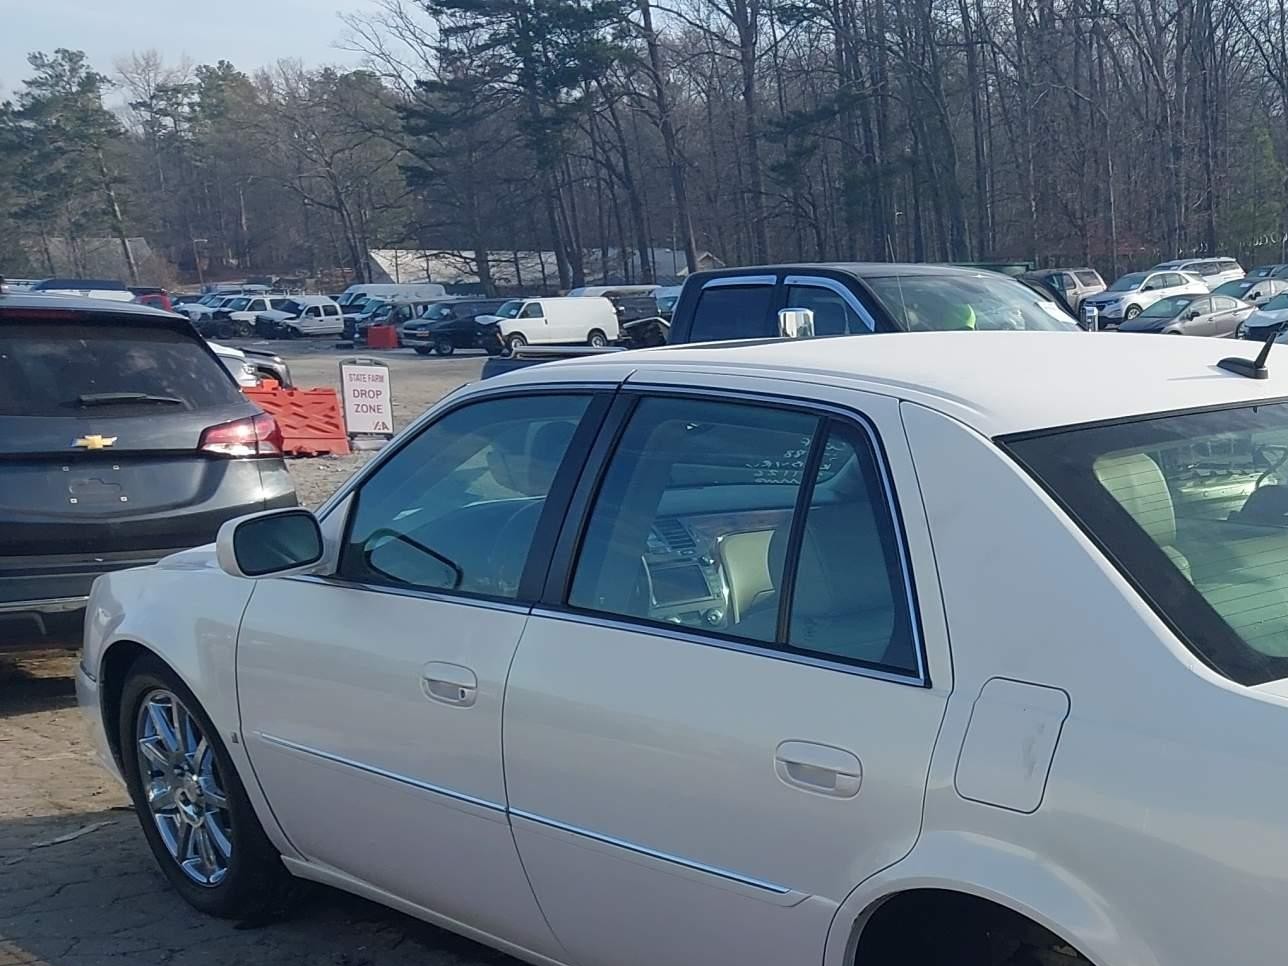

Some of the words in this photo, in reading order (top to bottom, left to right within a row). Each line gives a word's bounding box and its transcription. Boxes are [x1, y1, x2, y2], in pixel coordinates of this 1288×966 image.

[348, 373, 367, 383] STATE
[368, 374, 384, 383] FARM
[352, 388, 382, 399] DROP
[354, 404, 383, 413] ZONE
